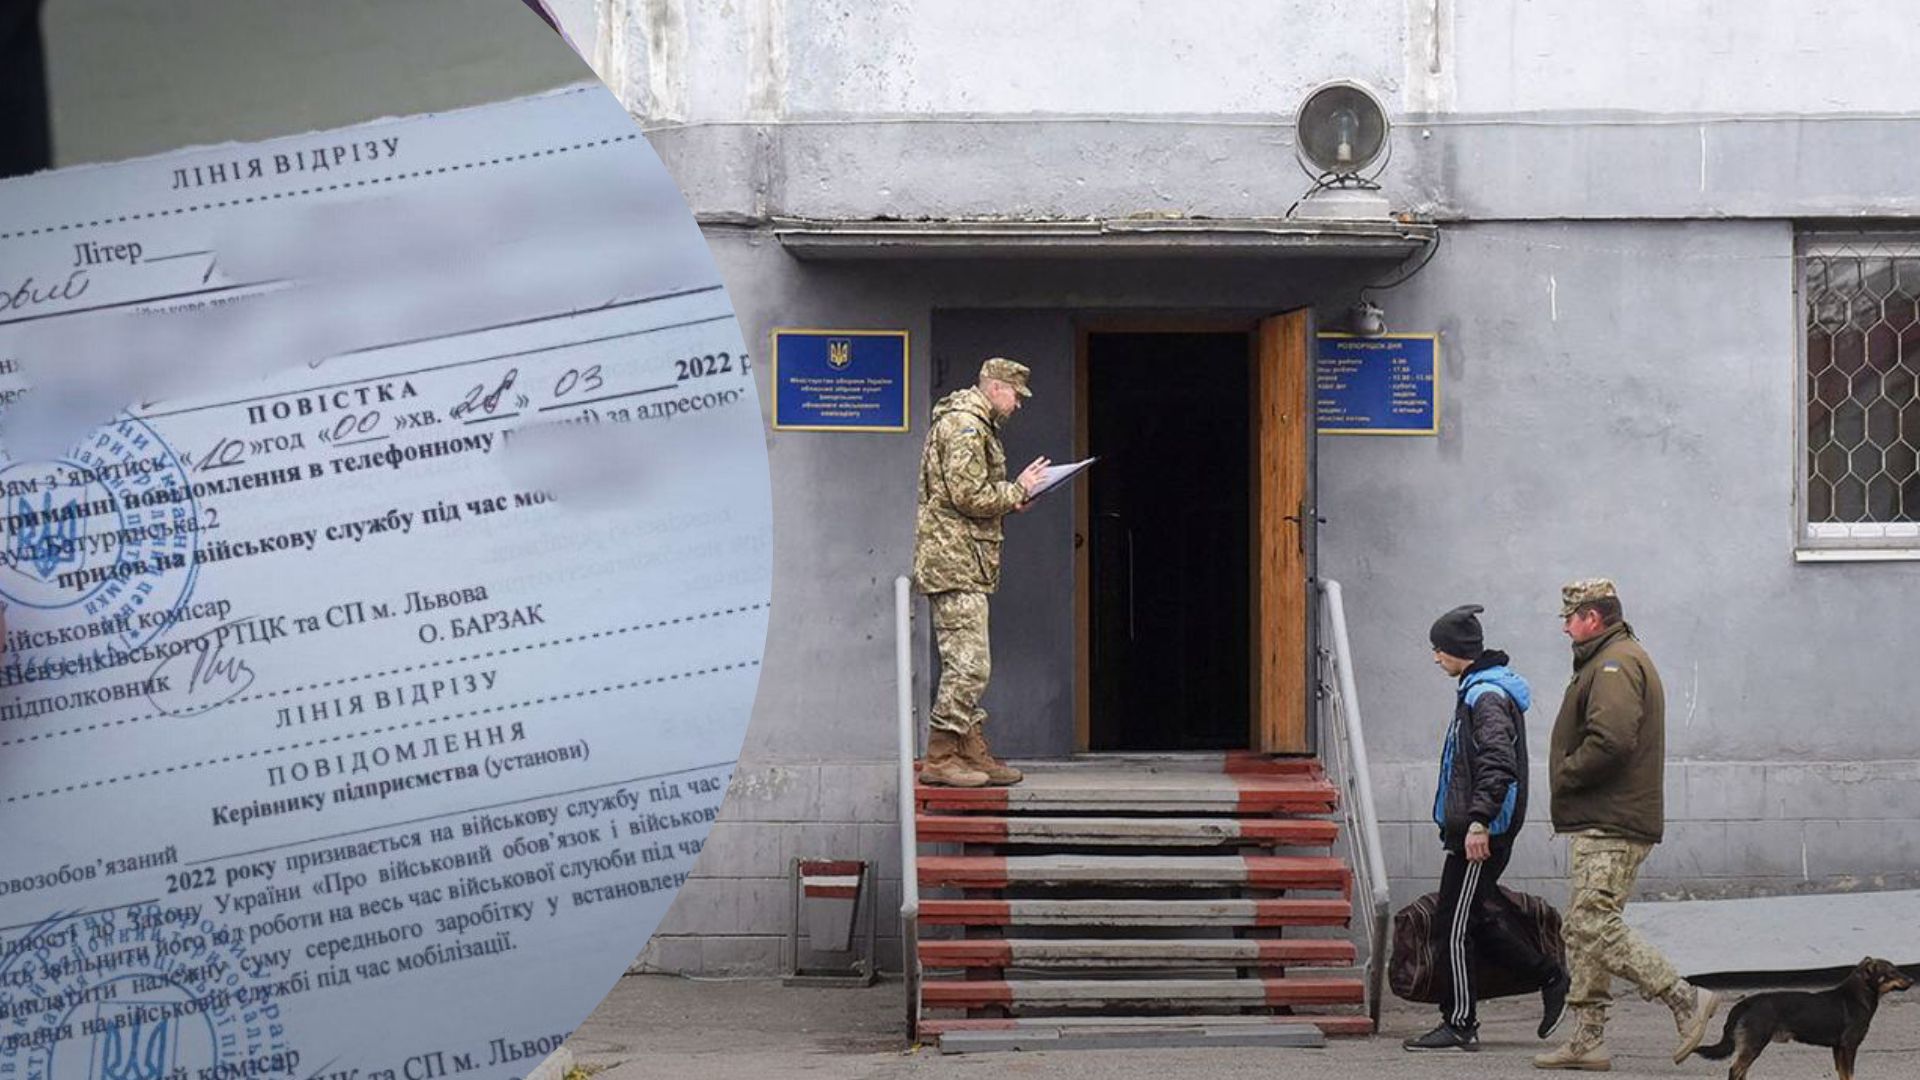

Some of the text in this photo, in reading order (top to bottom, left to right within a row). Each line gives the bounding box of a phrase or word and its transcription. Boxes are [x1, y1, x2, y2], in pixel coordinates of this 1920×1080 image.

[172, 137, 400, 190] ЛІНІЯ ВІДРІЗУ
[73, 240, 143, 267] Літер
[675, 352, 732, 381] 2022
[248, 381, 418, 424] ПОВІСТКА
[308, 462, 323, 479] в
[330, 432, 495, 473] телефонному
[154, 551, 185, 571] на
[194, 526, 317, 564] військову
[325, 508, 415, 543] службу
[423, 501, 462, 524] під
[467, 496, 507, 514] час
[215, 616, 288, 650] РТЦК
[293, 617, 320, 635] та
[326, 602, 366, 629] СП
[371, 603, 397, 620] м.
[404, 585, 489, 615] Львова
[419, 603, 545, 644] О. БАРЗАК
[0, 676, 171, 721] підполковник
[276, 670, 498, 728] ЛІНІЯ ВІДРІЗУ
[212, 738, 591, 826] Керівнику підприємства (установи)
[268, 721, 526, 787] ПОВІДОМЛЕННЯ
[165, 776, 721, 894] 2022 року призивається на військову службу під час
[214, 885, 301, 915] України
[312, 871, 367, 896] «Про
[379, 845, 492, 883] військовий
[611, 821, 619, 839] і
[249, 912, 324, 944] роботи
[329, 907, 354, 923] на
[359, 897, 403, 918] весь
[408, 889, 442, 907] час
[449, 862, 554, 900] військової
[642, 845, 673, 863] під
[305, 922, 423, 960] середнього
[436, 899, 534, 935] заробітку
[547, 897, 559, 917] у
[81, 1015, 108, 1036] на
[317, 967, 351, 988] під
[356, 959, 390, 979] час
[397, 931, 518, 973] мобілізації.
[403, 1052, 446, 1080] СП
[454, 1056, 480, 1074] м.
